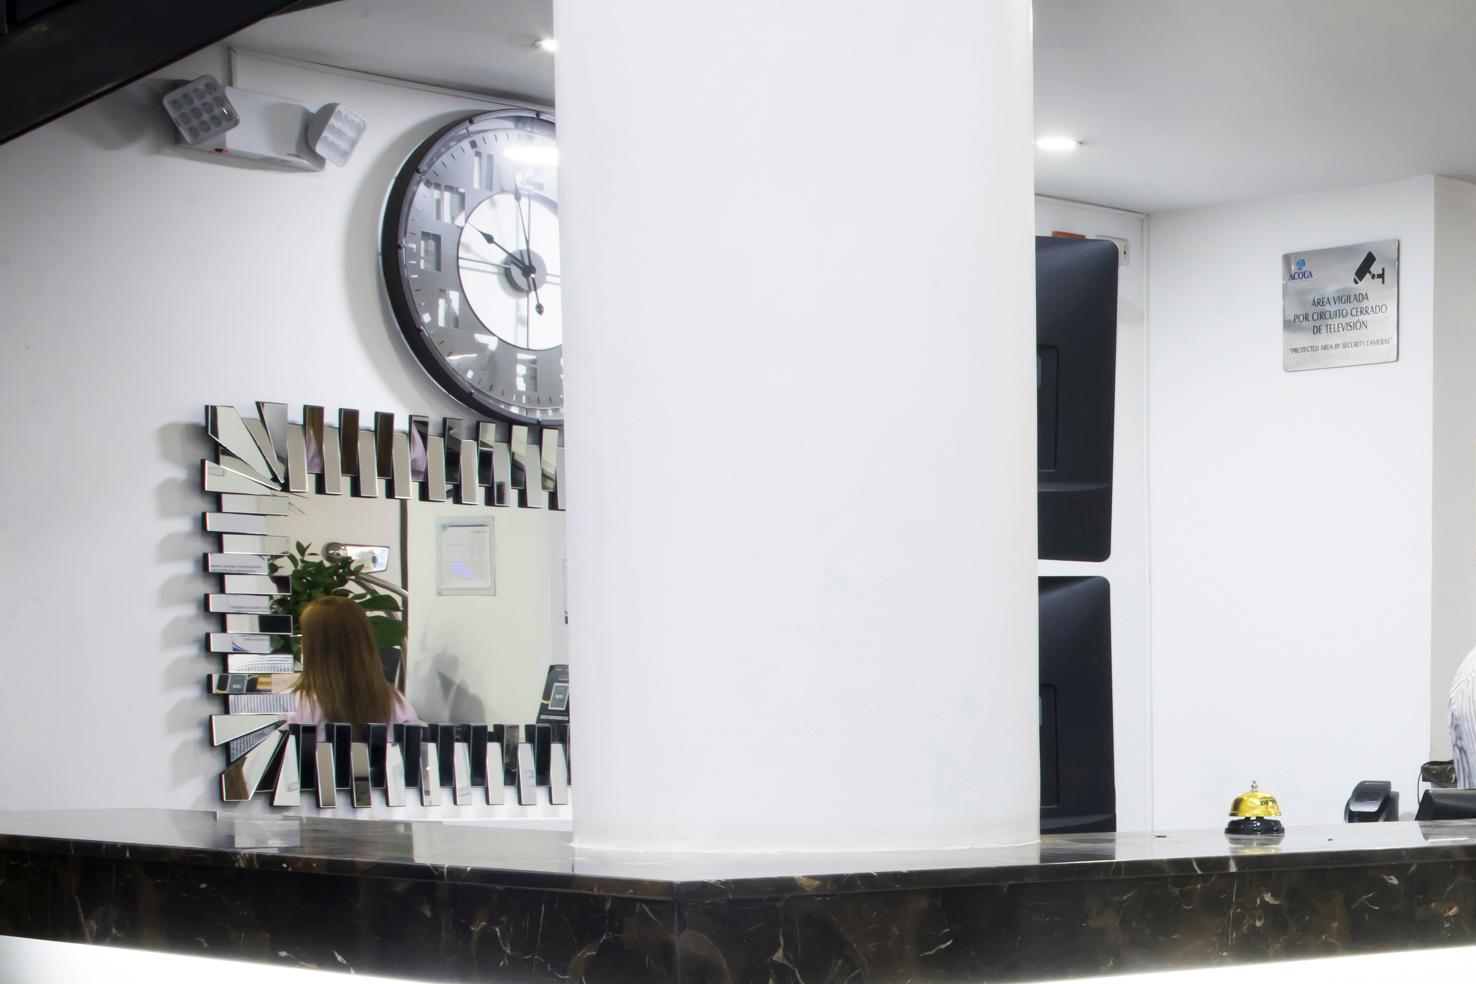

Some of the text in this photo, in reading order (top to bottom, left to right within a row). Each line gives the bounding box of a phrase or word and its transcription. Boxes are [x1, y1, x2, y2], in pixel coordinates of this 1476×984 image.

[1288, 270, 1313, 281] ACQUA
[1311, 292, 1370, 308] ÁREA VIGILADA
[1293, 304, 1388, 324] POR CIRCUITO CERRADO
[1312, 319, 1368, 335] DE TELEVISIÓN
[1341, 340, 1365, 349] SECURITY
